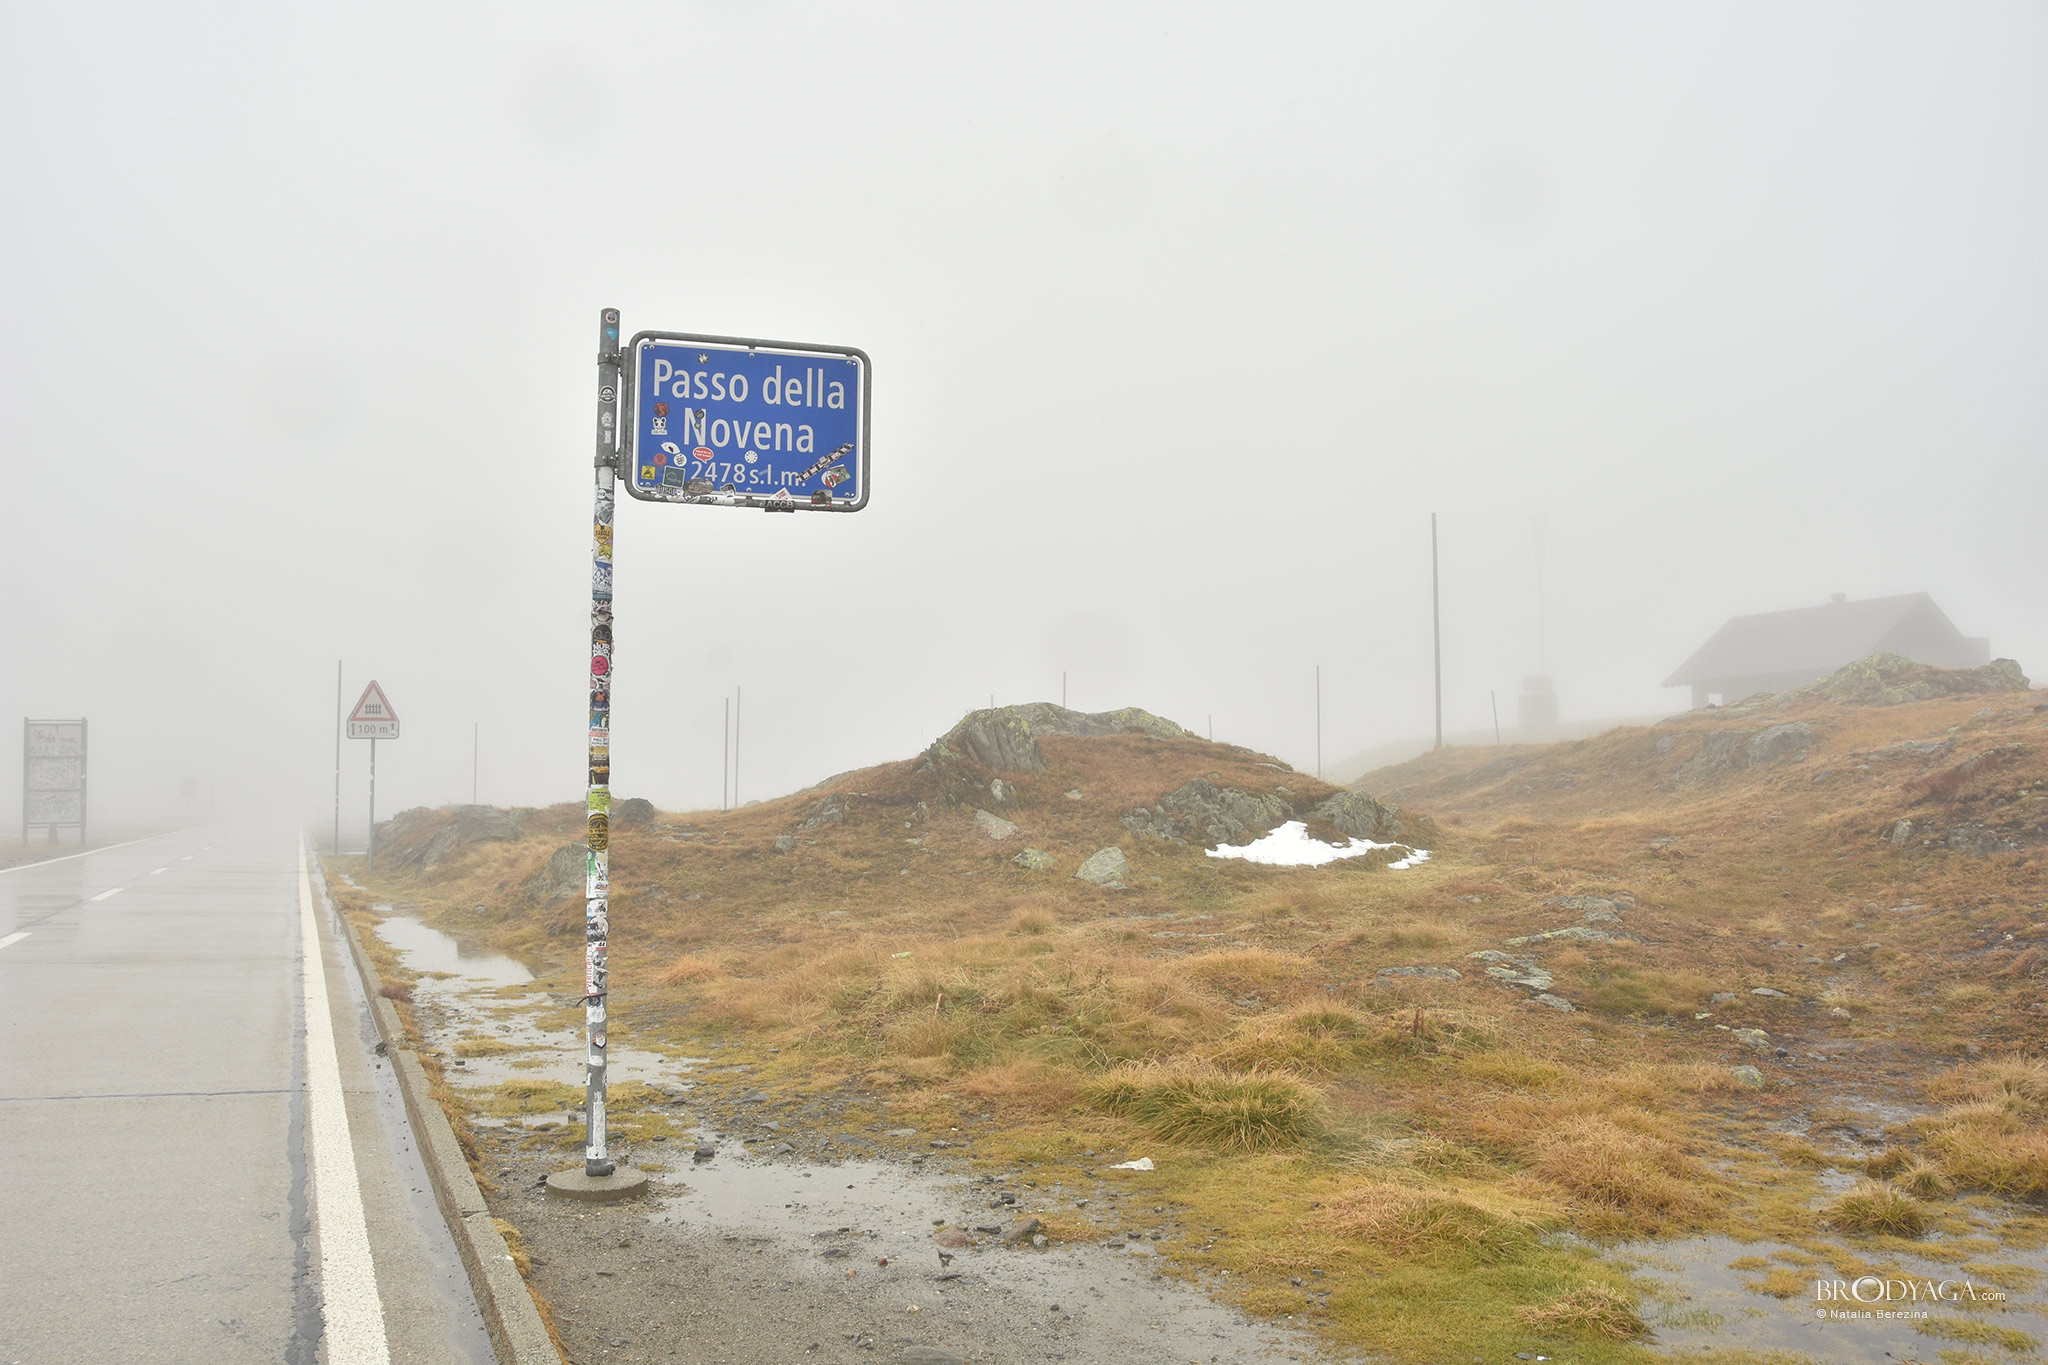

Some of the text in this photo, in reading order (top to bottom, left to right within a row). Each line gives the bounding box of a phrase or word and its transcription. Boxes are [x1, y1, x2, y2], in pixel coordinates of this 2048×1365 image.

[653, 358, 846, 409] Passo della
[684, 407, 815, 453] Novena
[690, 461, 746, 483] 2478
[358, 724, 388, 734] 100 m
